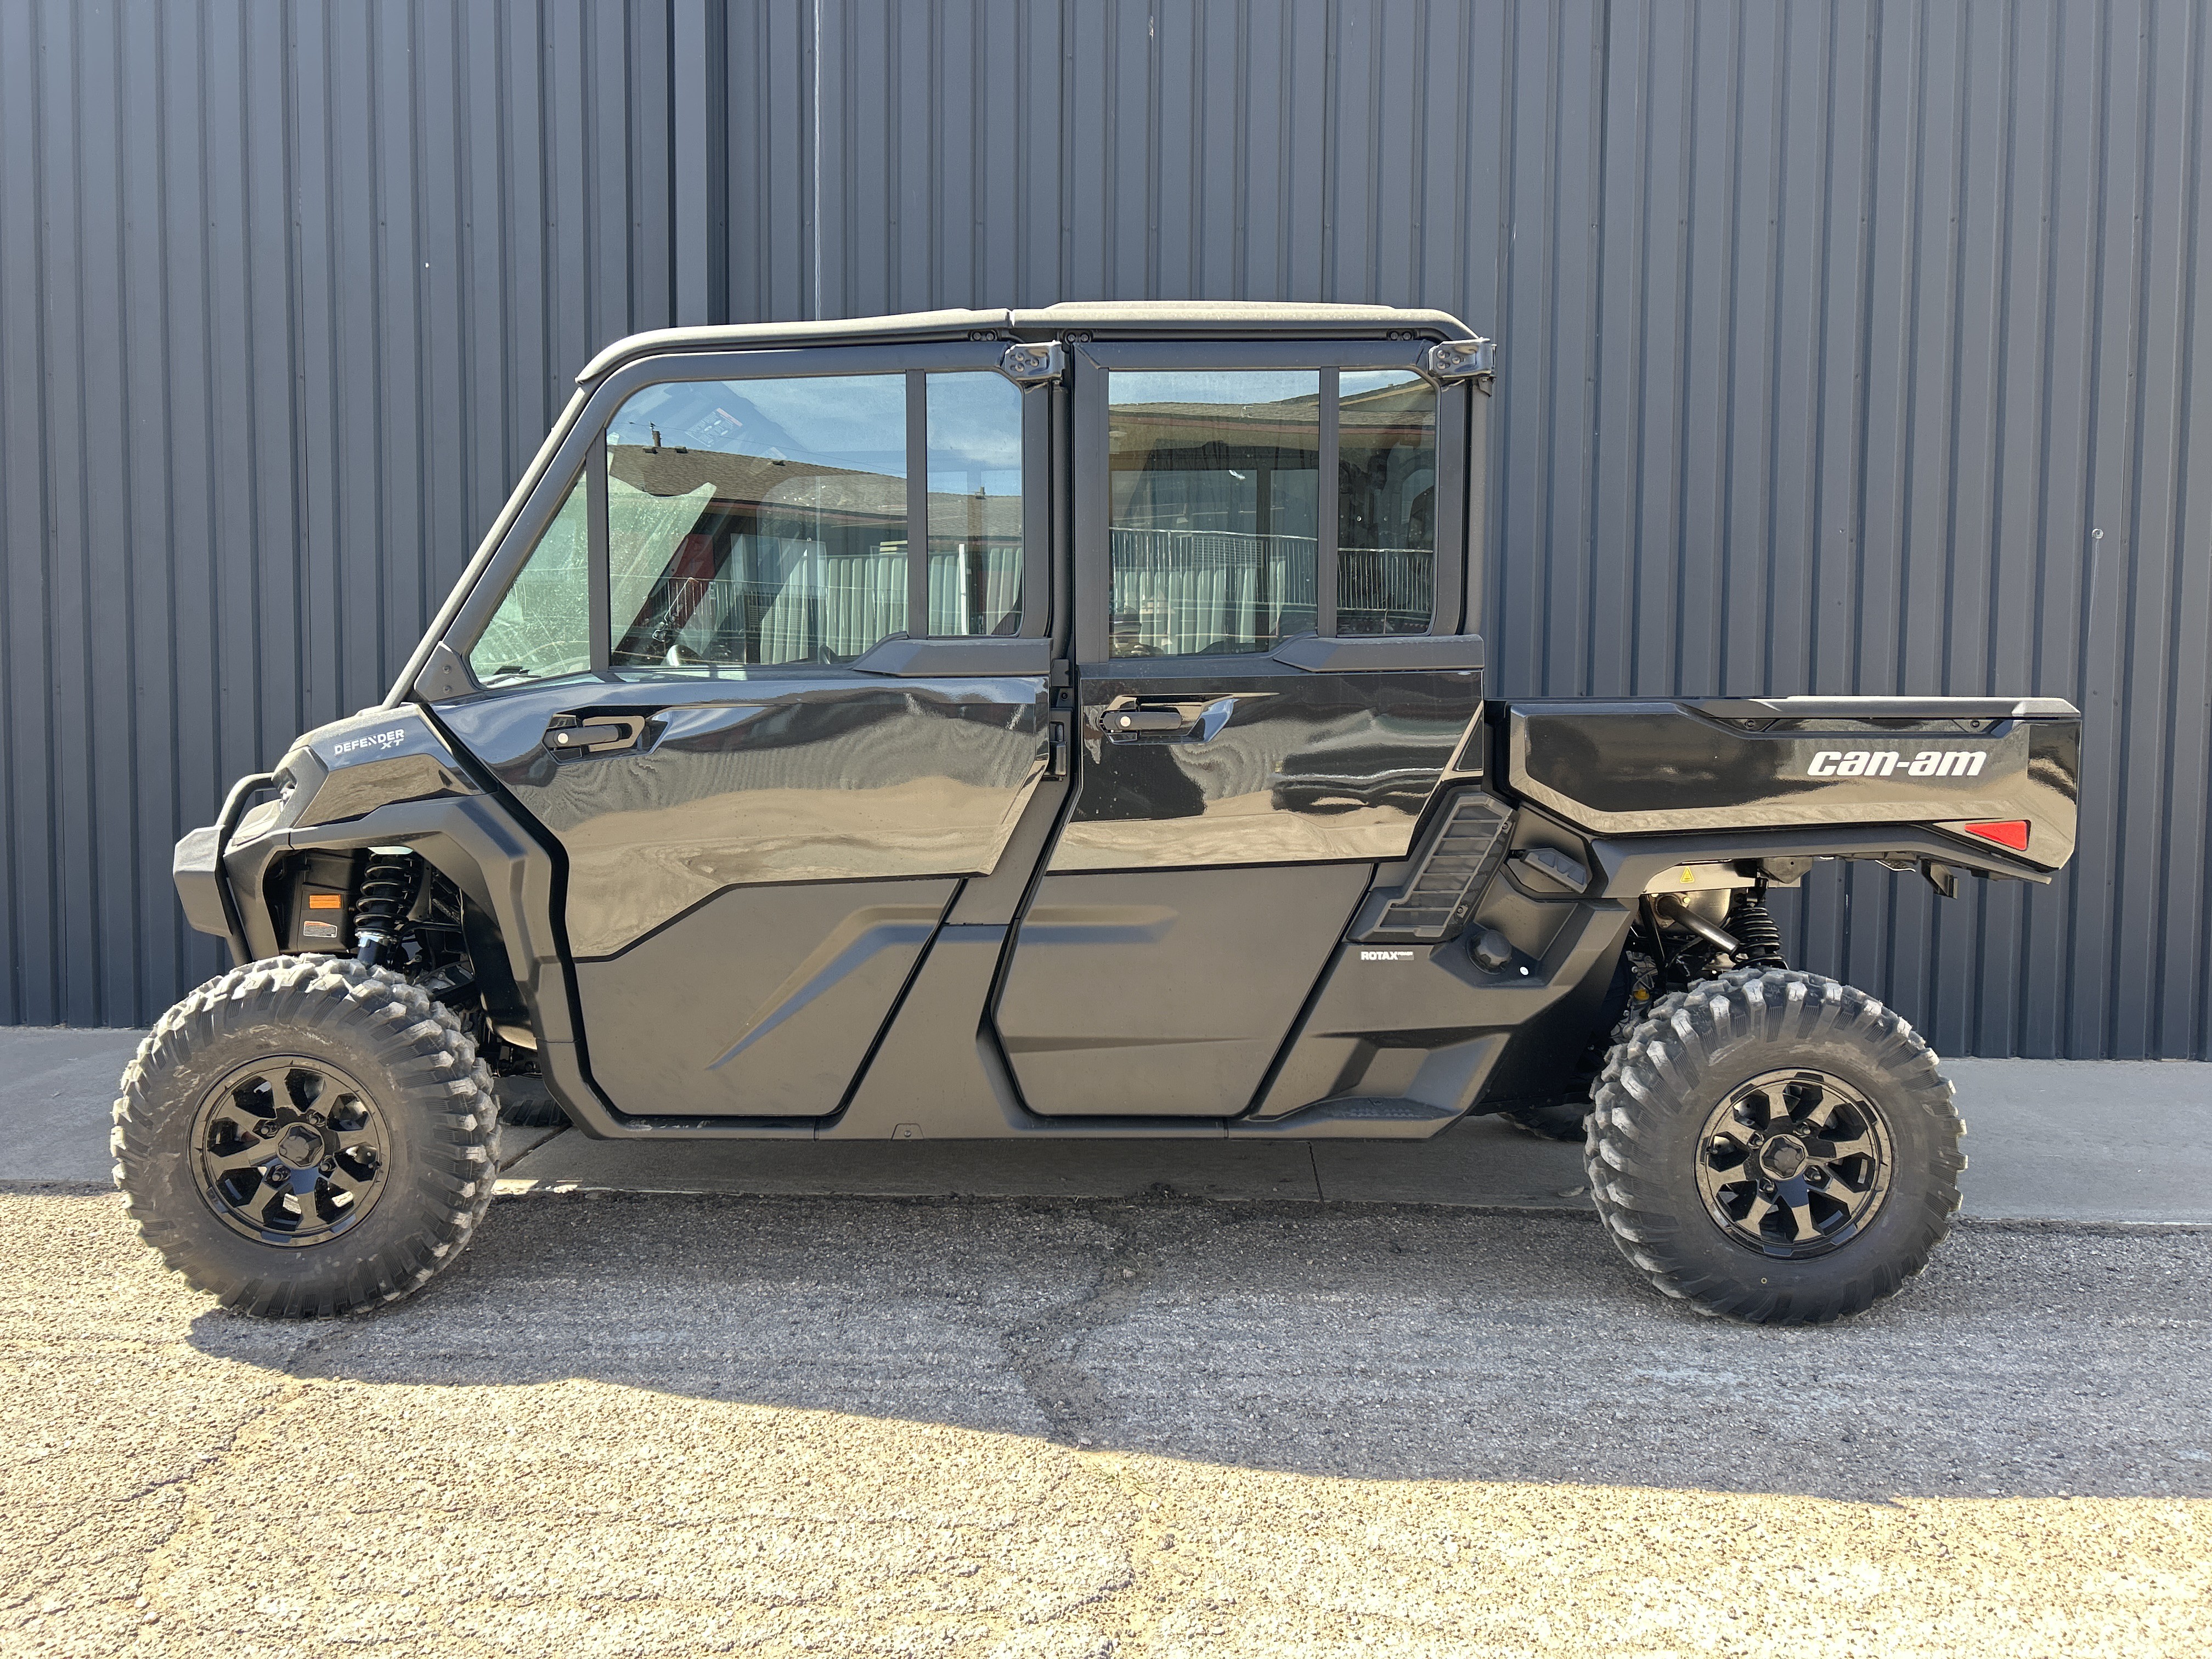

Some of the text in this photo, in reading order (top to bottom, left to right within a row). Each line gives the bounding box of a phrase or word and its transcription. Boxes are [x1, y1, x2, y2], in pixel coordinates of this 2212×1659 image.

[334, 729, 404, 755] DEFENDER
[380, 738, 404, 750] XT
[1807, 751, 1987, 776] can-am
[1361, 951, 1398, 960] ROTAX
